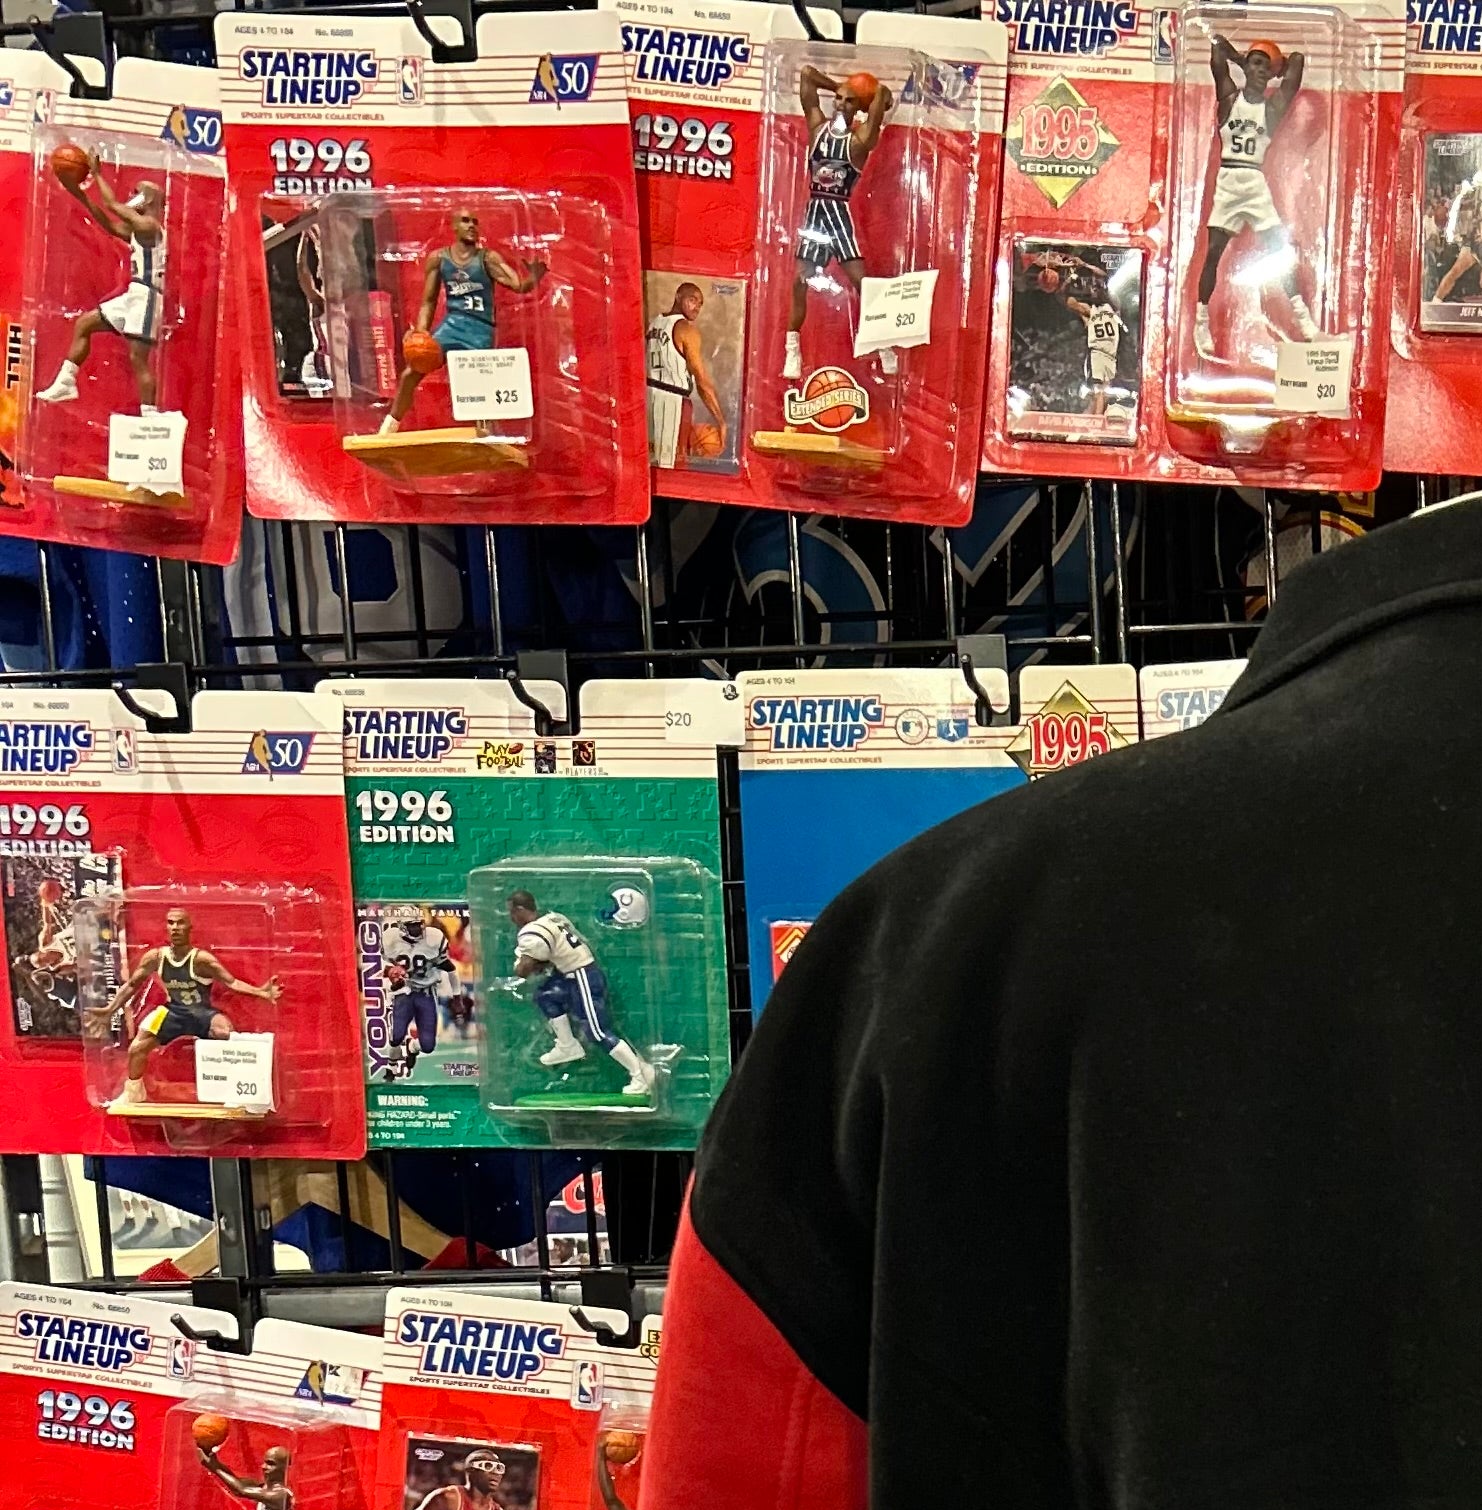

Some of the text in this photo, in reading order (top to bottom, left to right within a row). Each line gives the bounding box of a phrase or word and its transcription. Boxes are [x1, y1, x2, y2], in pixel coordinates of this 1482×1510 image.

[996, 0, 1138, 30] STARTING
[621, 25, 750, 63] STARTING
[1016, 26, 1118, 55] LINEUP
[243, 51, 377, 78] STARTING
[637, 61, 733, 87] LINEUP
[267, 78, 361, 104] LINEUP
[558, 62, 589, 95] 50
[241, 112, 385, 121] SPORTS SUPERSTAR COLLECTIBLES
[191, 117, 222, 146] 50
[634, 115, 734, 156] 1996
[1019, 104, 1099, 159] 1995
[270, 139, 372, 174] 1996
[1231, 136, 1257, 155] 50
[634, 153, 732, 180] EDITION
[1026, 163, 1092, 176] EDITION
[274, 177, 373, 195] EDITION
[464, 297, 485, 312] 33
[896, 313, 916, 327] $20
[1094, 322, 1116, 339] 50
[7, 324, 21, 389] HILL
[495, 390, 519, 404] $25
[1316, 383, 1336, 399] $20
[148, 456, 168, 471] $20
[344, 711, 467, 735] STARTING
[665, 712, 693, 728] $20
[752, 698, 883, 726] STARTING
[0, 724, 93, 748] ARTING
[360, 735, 451, 760] LINEUP
[483, 741, 510, 756] PLAY
[772, 724, 866, 749] LINEUP
[1028, 713, 1112, 770] 1995
[2, 748, 77, 772] INEUP
[272, 740, 303, 767] 50
[476, 753, 526, 770] FOOTBALL
[46, 780, 102, 788] COLLECTIBLES
[356, 790, 453, 822] 1996
[0, 804, 91, 837] 1996
[360, 825, 455, 843] EDITION
[0, 839, 91, 856] EDITION
[431, 909, 471, 919] FAULK
[359, 920, 388, 1078] YOUNG
[236, 1082, 258, 1097] $20
[377, 1095, 429, 1108] WARNING:
[18, 1314, 150, 1351] STARTING
[400, 1314, 563, 1354] STARTING
[38, 1339, 133, 1370] LINEUP
[422, 1346, 541, 1380] LINEUP
[409, 1376, 551, 1395] SPORTS SUPERSTAR COLLECTIBLES
[37, 1390, 135, 1430] 1996
[38, 1421, 135, 1450] EDITION
